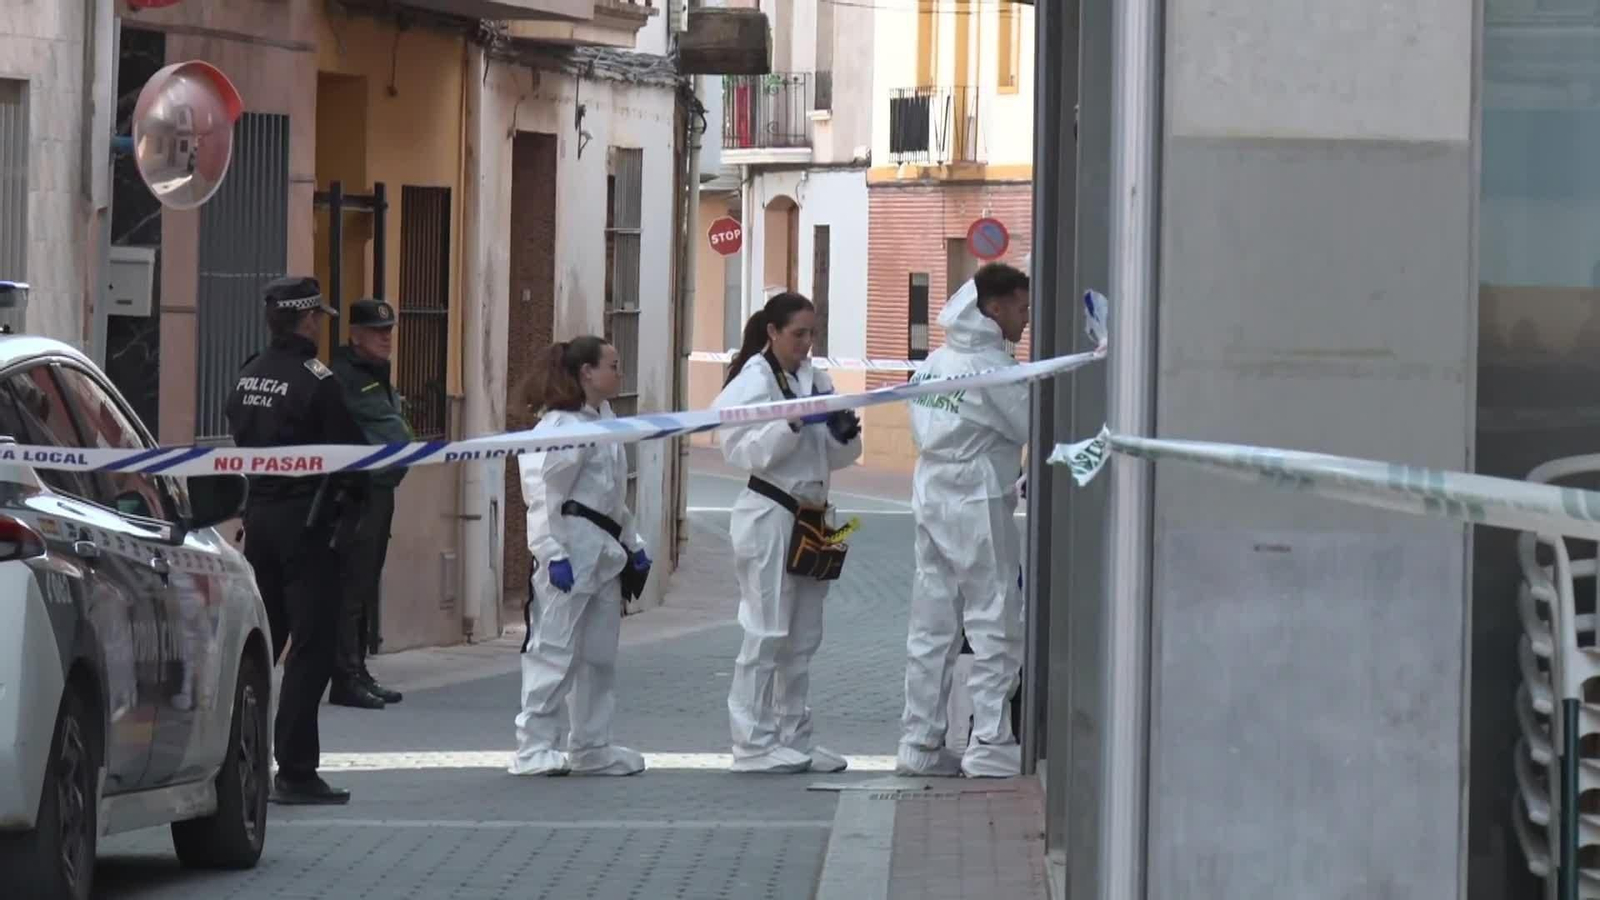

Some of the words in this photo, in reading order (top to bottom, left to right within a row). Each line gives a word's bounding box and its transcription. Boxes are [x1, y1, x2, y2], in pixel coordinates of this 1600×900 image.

[711, 229, 741, 245] STOP
[236, 377, 289, 396] POLICIA
[242, 394, 274, 407] LOCAL
[23, 450, 88, 465] LOCAL
[213, 456, 244, 471] NO
[251, 456, 323, 471] PASAR
